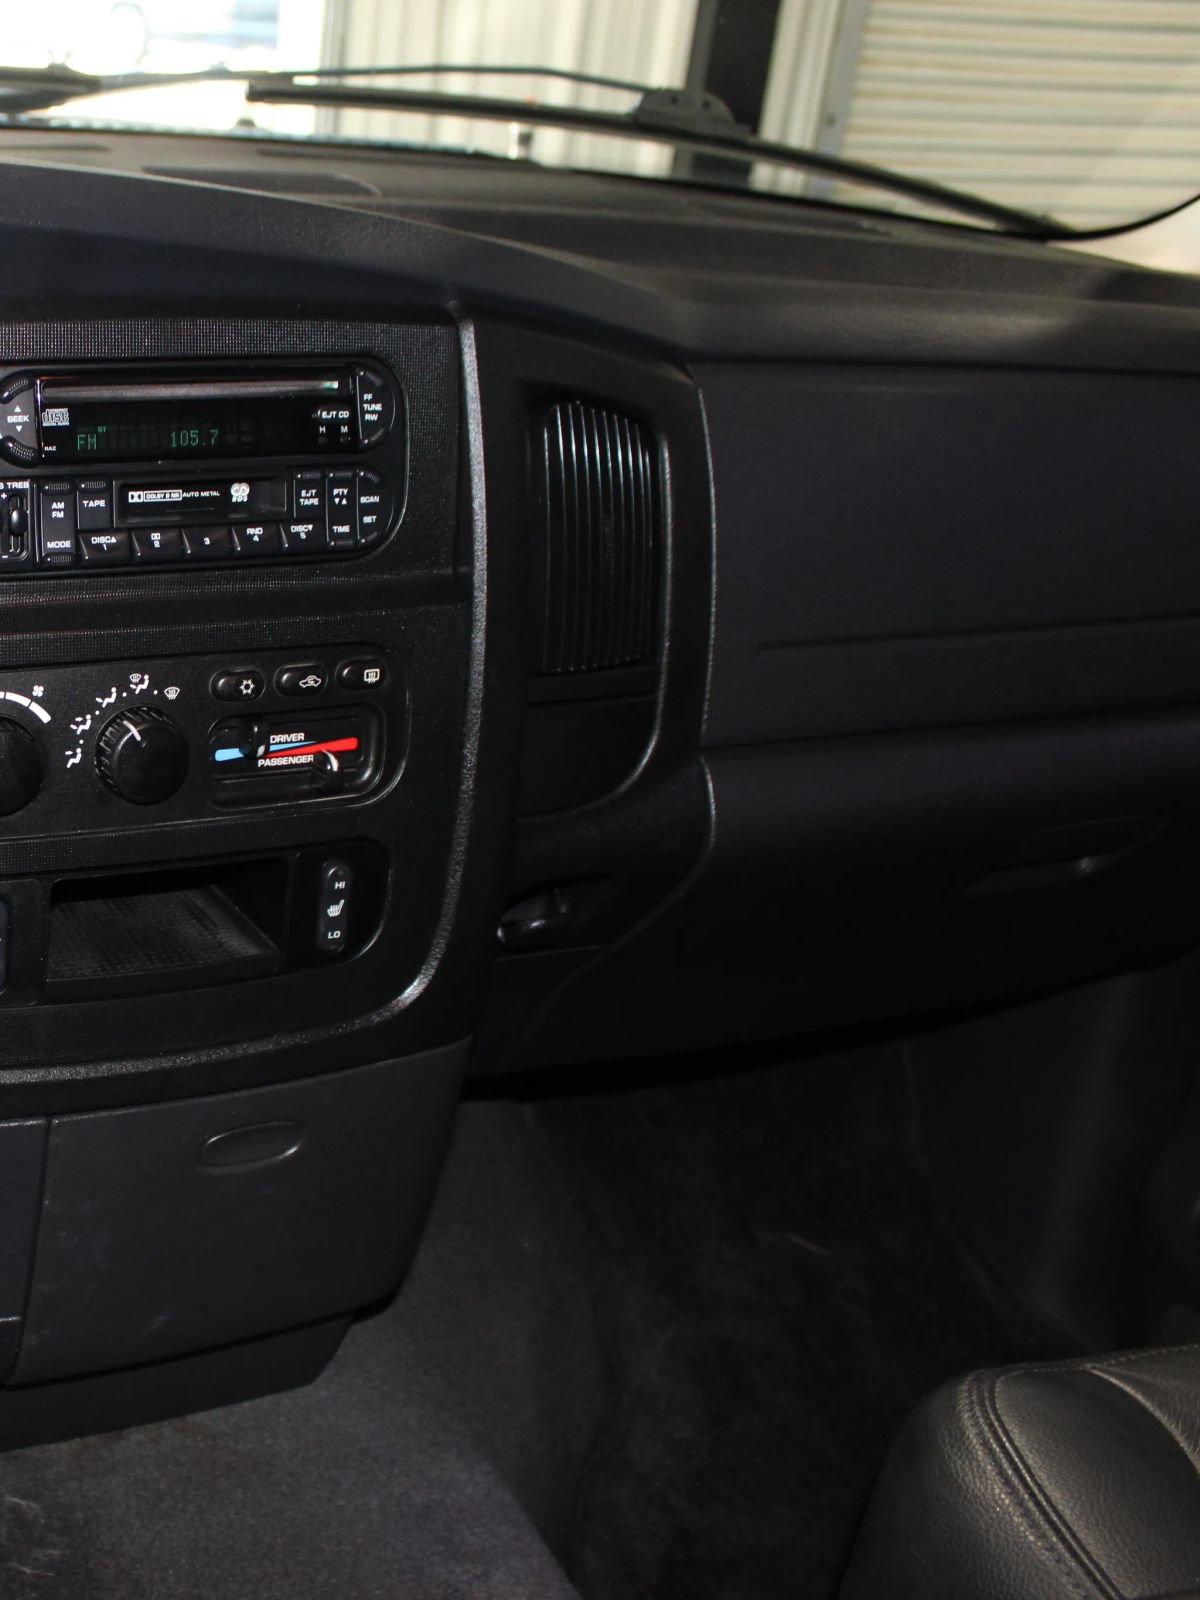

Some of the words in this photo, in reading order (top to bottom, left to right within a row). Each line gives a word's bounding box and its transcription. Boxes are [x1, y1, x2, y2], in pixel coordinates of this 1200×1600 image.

[363, 403, 382, 411] TUNE
[7, 415, 29, 423] SEEK
[365, 413, 378, 421] RW
[77, 433, 97, 451] FM
[170, 429, 219, 448] 105.7
[6, 481, 29, 489] TREB
[82, 500, 106, 508] TAPE
[360, 496, 380, 504] SCAN
[51, 502, 65, 510] AM
[52, 511, 64, 519] FM
[246, 527, 263, 535] RND
[332, 525, 350, 533] TIME
[203, 537, 210, 545] 3
[270, 732, 305, 744] DRIVER
[257, 754, 314, 767] PASSENGER
[334, 881, 346, 889] HI
[328, 930, 341, 939] LO
